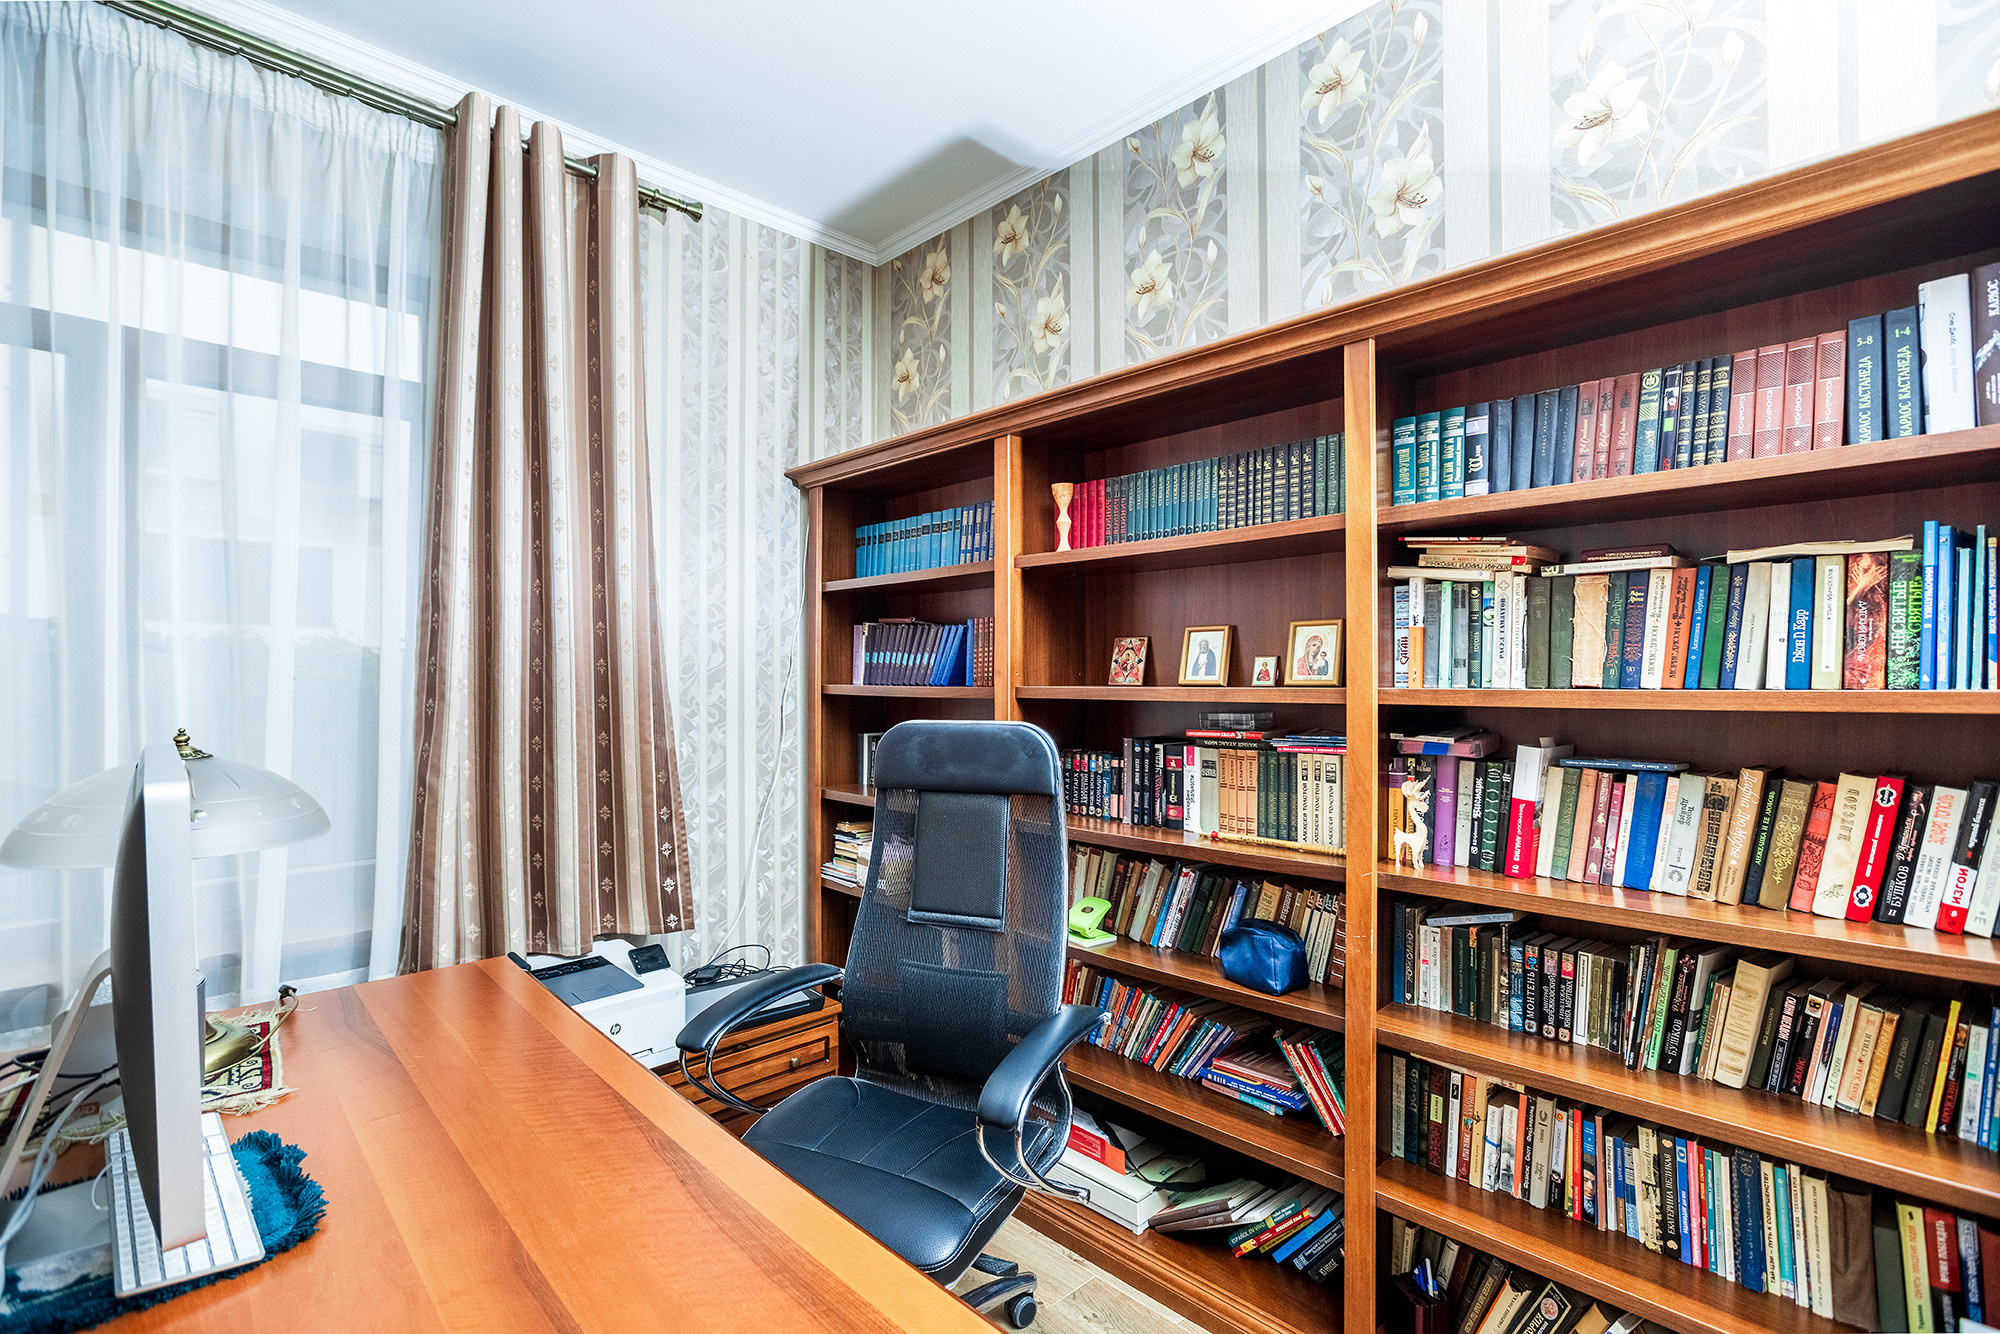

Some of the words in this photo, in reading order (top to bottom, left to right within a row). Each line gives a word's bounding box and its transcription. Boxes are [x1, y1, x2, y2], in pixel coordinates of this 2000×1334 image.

[1856, 336, 1873, 346] 5-8
[1895, 326, 1911, 338] 1-4
[1859, 356, 1873, 409] КАСТАНЕДА
[1897, 345, 1912, 400] КАСТАНЕДА
[1859, 410, 1871, 444] КАРЛОС
[1899, 402, 1912, 437] КАРЛОС
[1418, 442, 1430, 464] ЙОГА
[1444, 437, 1455, 460] ЙОГА
[1397, 448, 1410, 488] КОНФУЦИЙ
[1418, 465, 1430, 487] АГНИ
[1443, 462, 1454, 483] АГНИ
[1924, 567, 1934, 619] ИНФОРМАТИКА
[1737, 770, 1760, 808] Дафна
[1766, 790, 1775, 815] ЛЮБОВЬ
[1736, 809, 1751, 829] Дю
[1764, 816, 1771, 825] ЕЕ
[1934, 794, 1955, 821] ТОПОЛЬ
[1514, 834, 1522, 861] АНАЛИЗ
[1696, 794, 1729, 893] СТЕНДАЛЬ
[1728, 824, 1747, 859] Морье
[1754, 832, 1767, 865] АНЖЕЛИКА
[1892, 865, 1909, 908] БУШКОВ
[1952, 867, 1969, 905] ИЗГОИ
[1526, 972, 1536, 1019] МОНТЕНЬ
[1668, 1018, 1683, 1057] БУШКОВ
[1861, 1033, 1872, 1058] СТИХИ
[1793, 1058, 1806, 1087] ДЖОЙС
[1664, 1152, 1673, 1188] ВЕЛИКАЯ
[1666, 1190, 1676, 1234] ЕКАТЕРИНА
[1763, 1171, 1772, 1224] СОВЕРШЕНСТВУ
[1230, 1230, 1250, 1246] ESPAÑOL
